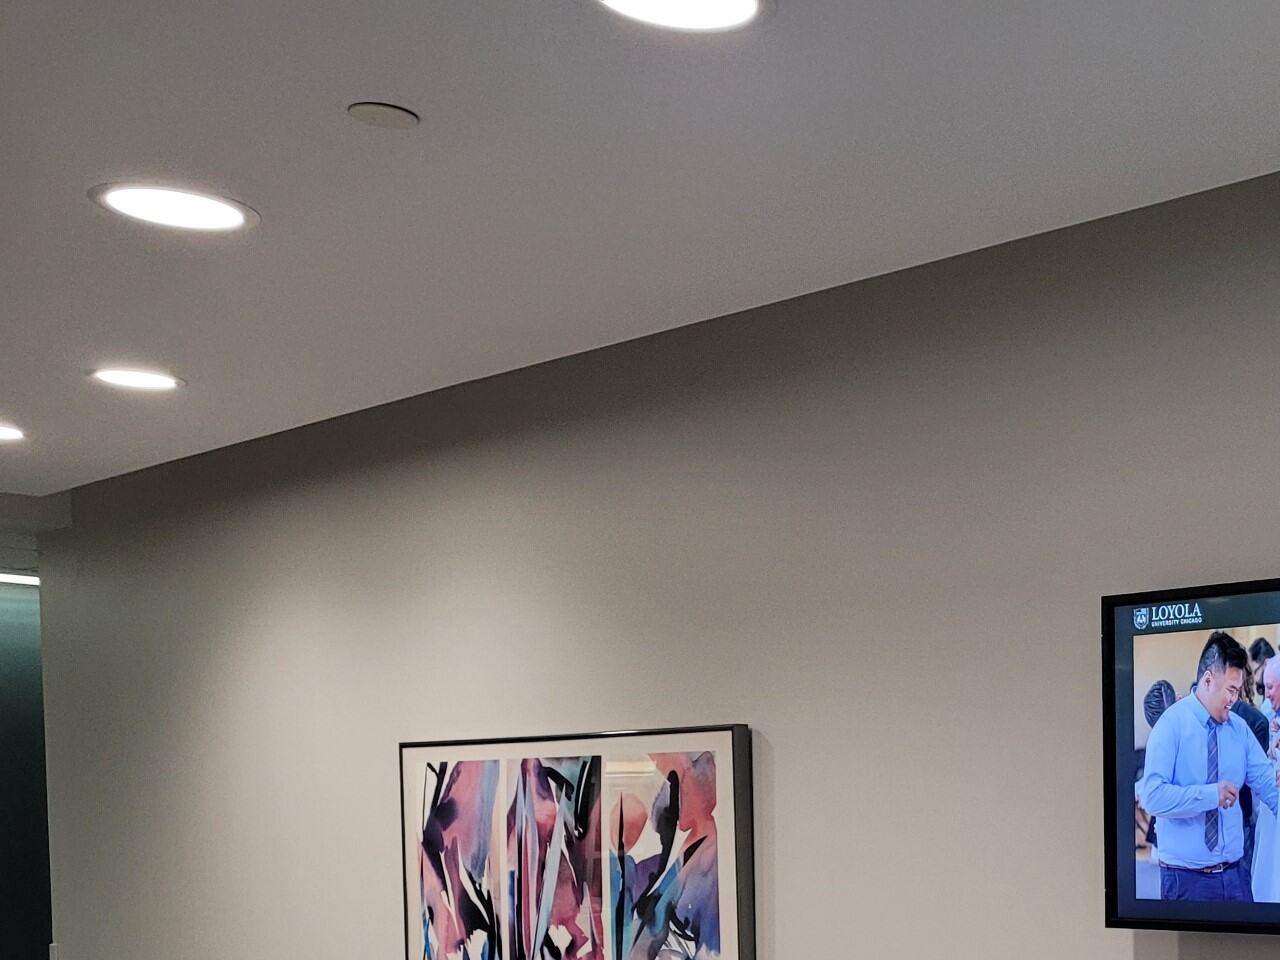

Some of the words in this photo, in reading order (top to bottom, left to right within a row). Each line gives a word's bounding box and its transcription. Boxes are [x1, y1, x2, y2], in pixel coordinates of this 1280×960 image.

[1151, 602, 1202, 621] LOYOLA
[1151, 619, 1180, 627] UNIVERSITY
[1180, 617, 1203, 625] CHICAGO
